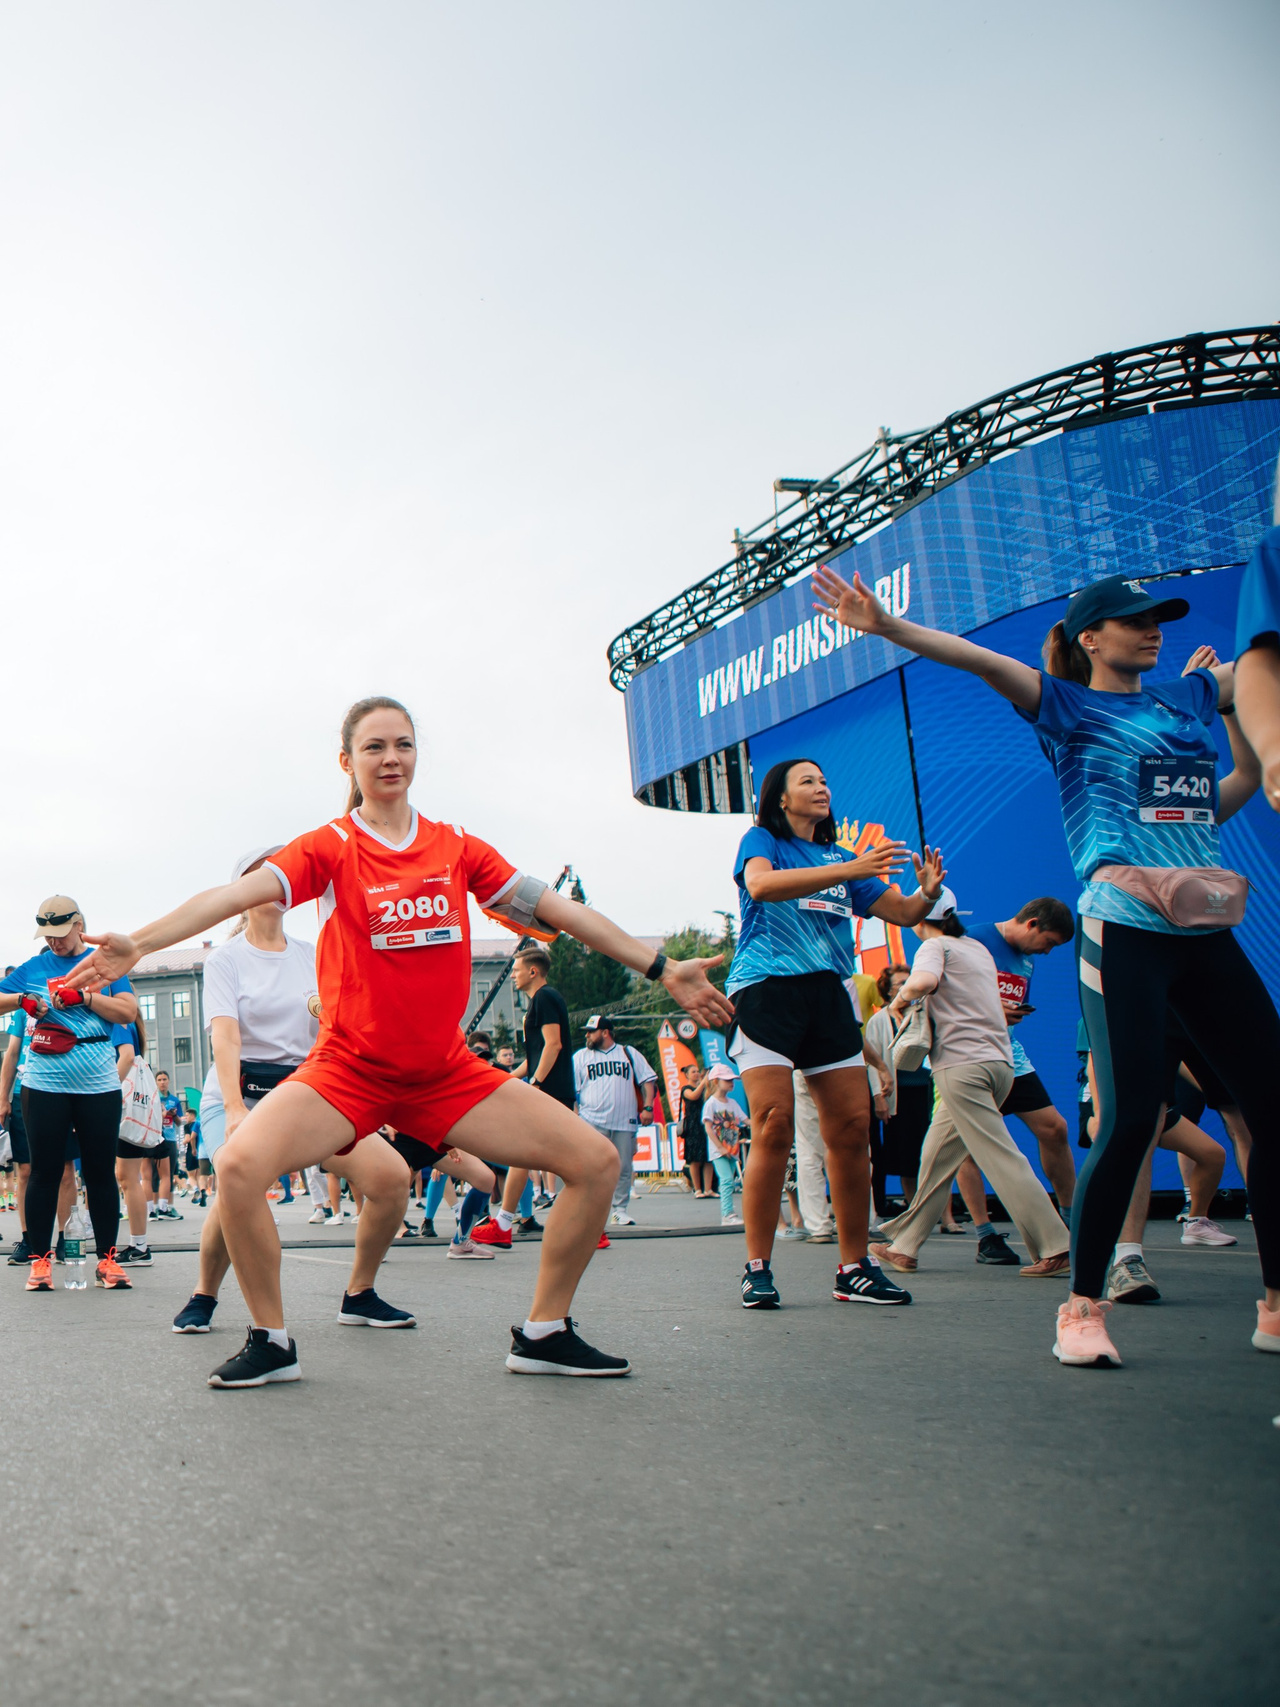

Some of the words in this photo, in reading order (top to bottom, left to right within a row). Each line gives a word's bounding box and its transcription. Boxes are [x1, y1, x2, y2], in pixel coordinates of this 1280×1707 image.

[1152, 775, 1210, 798] 5420
[378, 894, 449, 922] 2080
[999, 981, 1024, 998] 2943
[683, 1024, 693, 1033] 40
[587, 1060, 630, 1081] ROUGH
